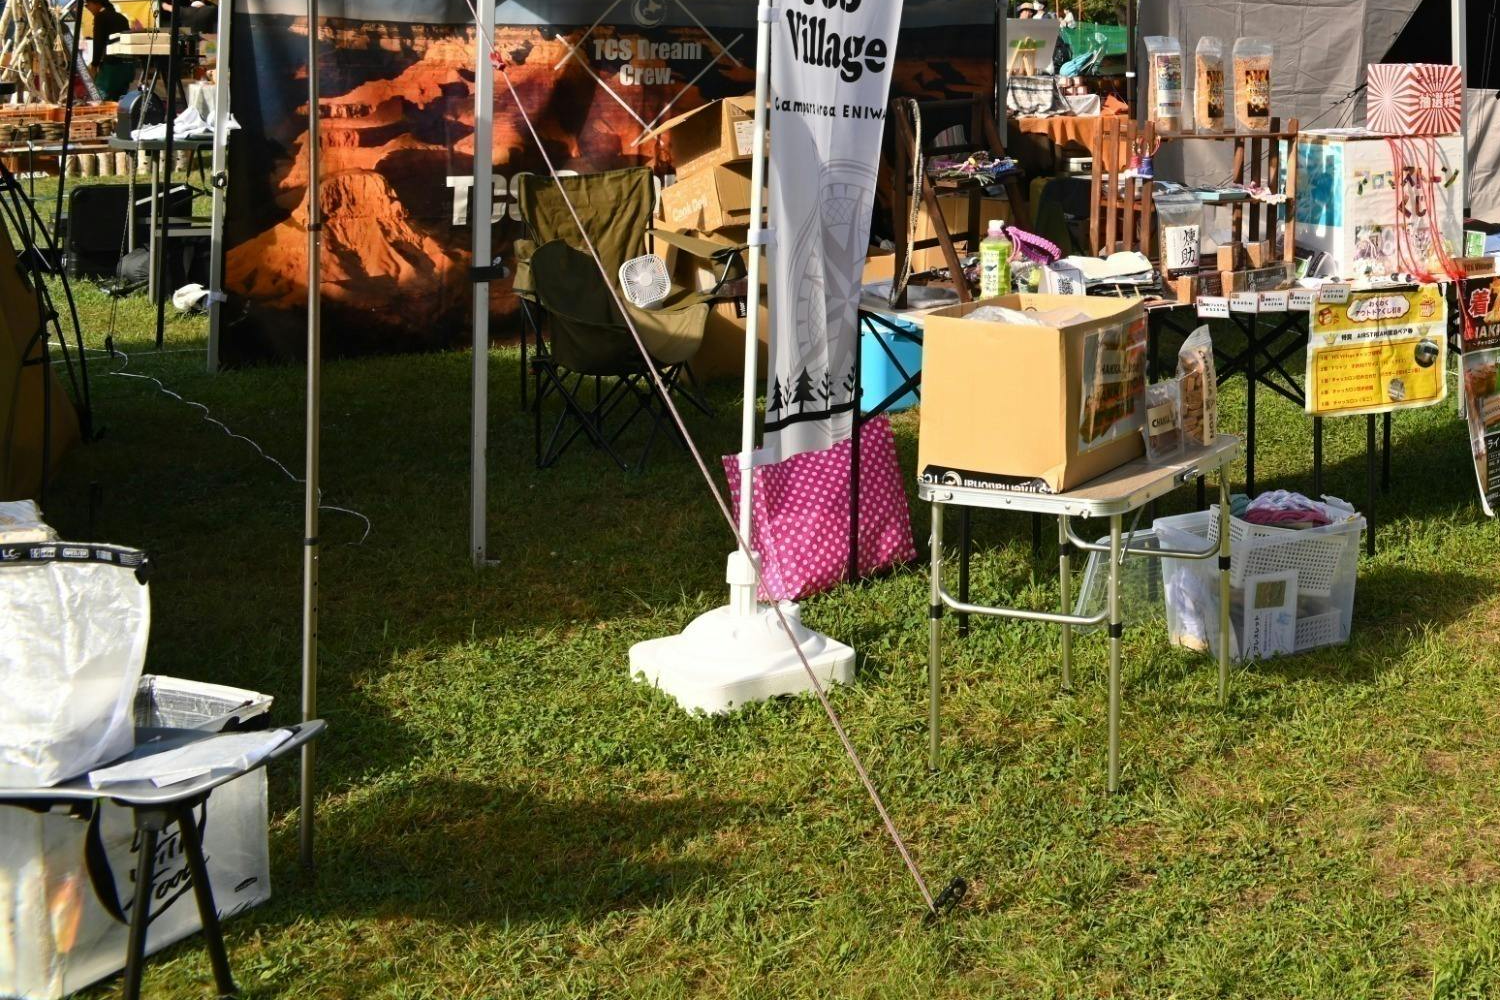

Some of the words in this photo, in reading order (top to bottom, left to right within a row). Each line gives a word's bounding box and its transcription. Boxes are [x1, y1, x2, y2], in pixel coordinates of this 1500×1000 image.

[593, 39, 632, 61] TCS
[637, 39, 702, 60] Dream
[786, 8, 888, 83] Village
[619, 64, 675, 86] Crew.
